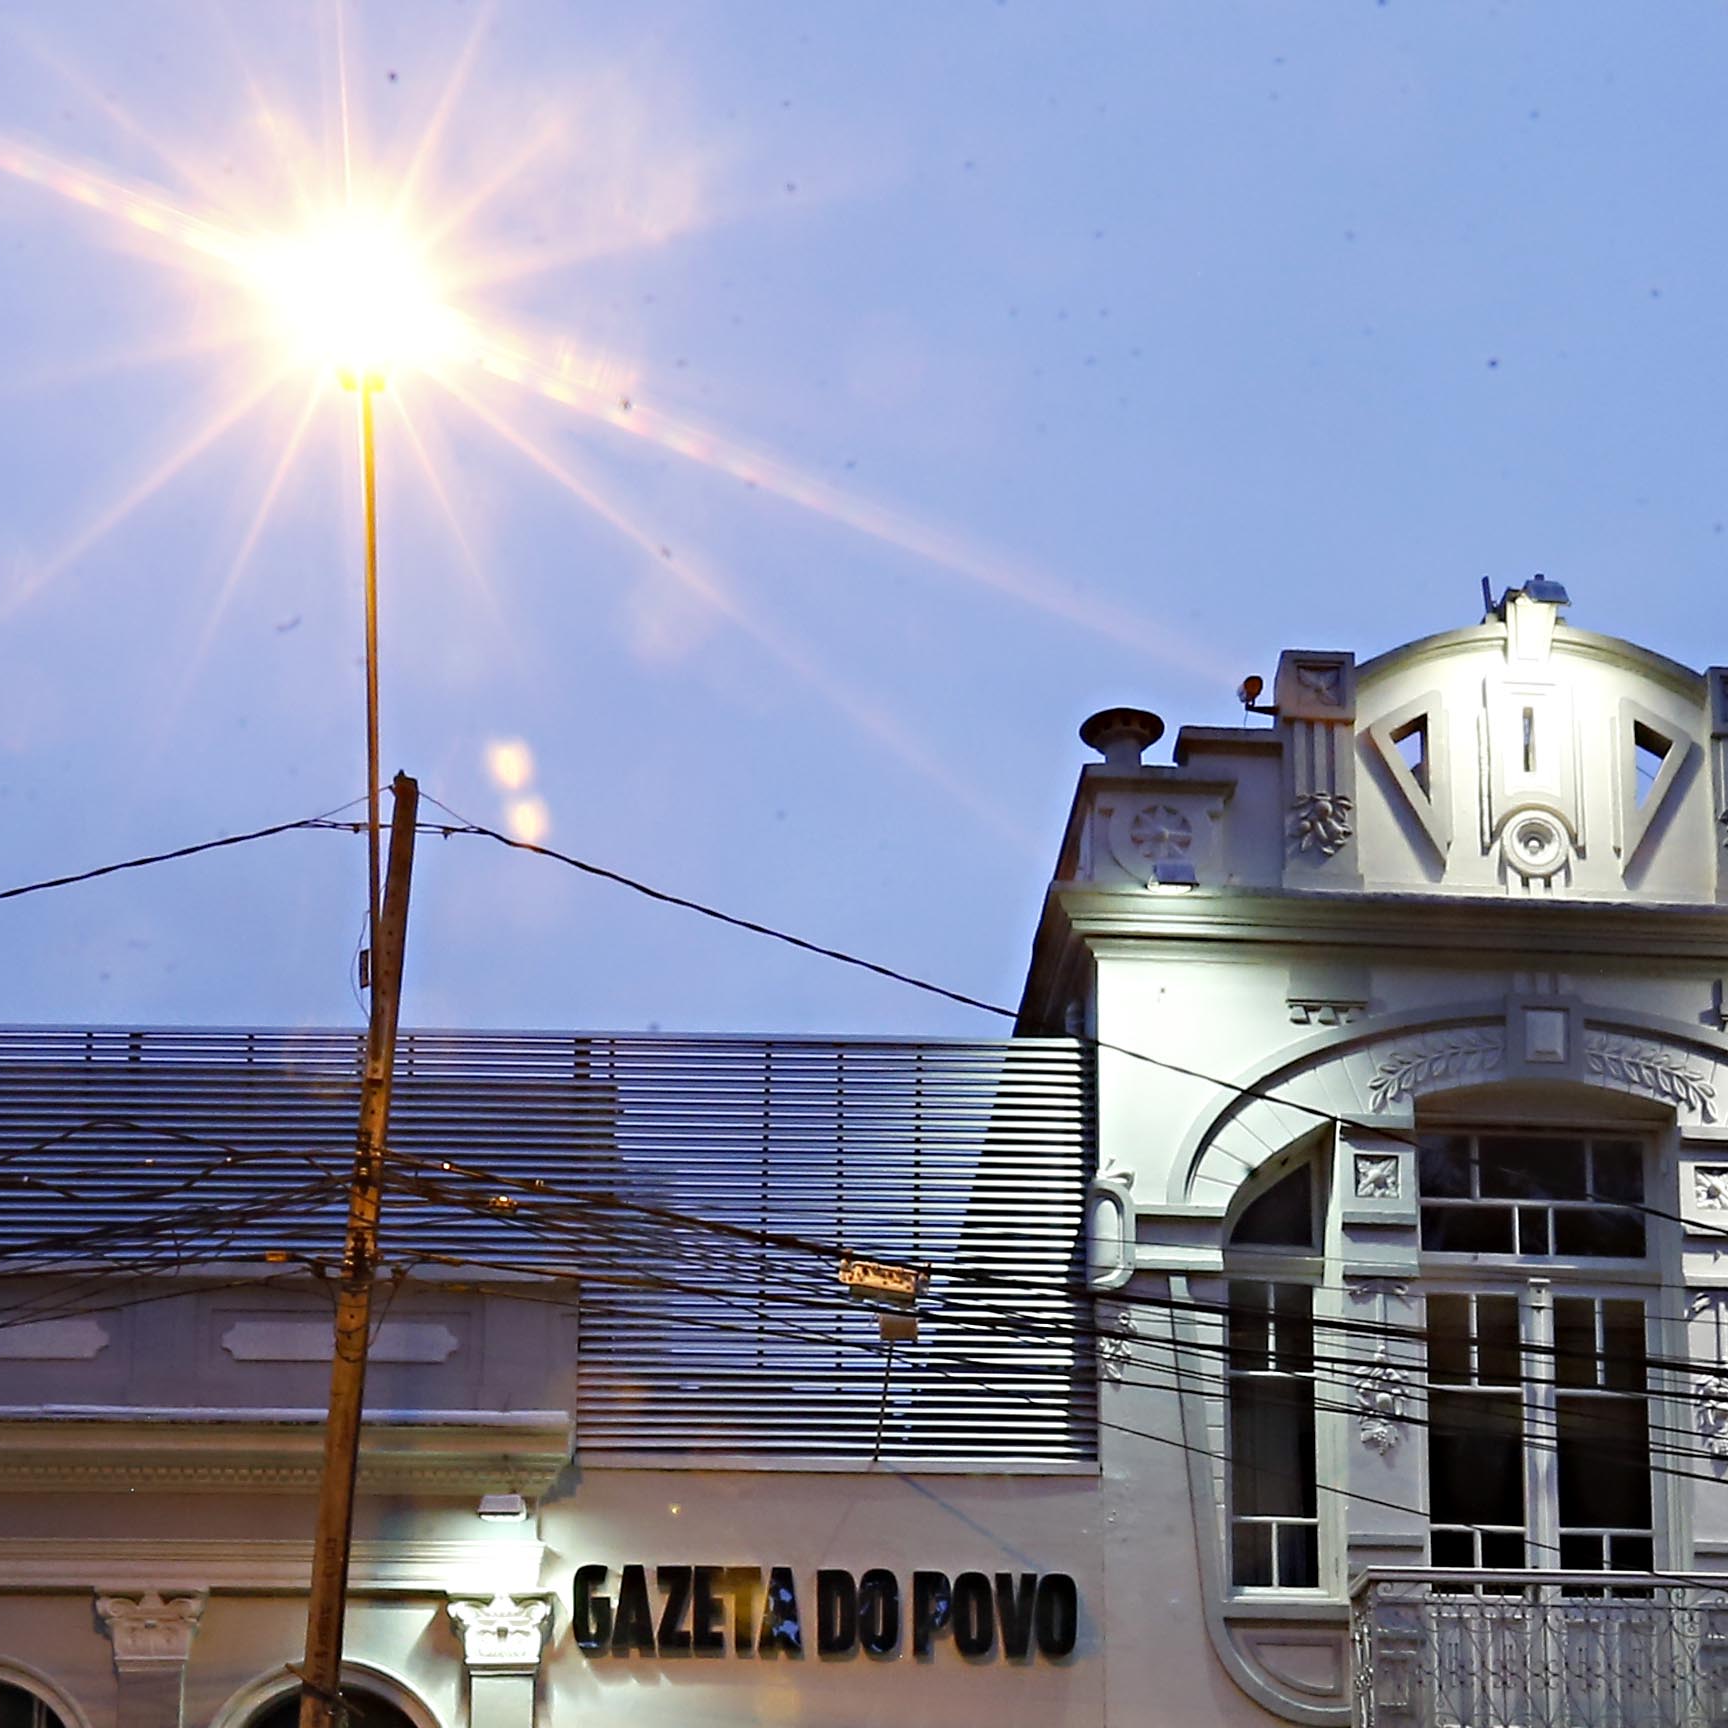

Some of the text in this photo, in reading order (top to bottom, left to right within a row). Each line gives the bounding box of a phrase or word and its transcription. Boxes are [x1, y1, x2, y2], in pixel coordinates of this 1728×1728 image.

[573, 1564, 1078, 1660] GAZETA DO POVO
